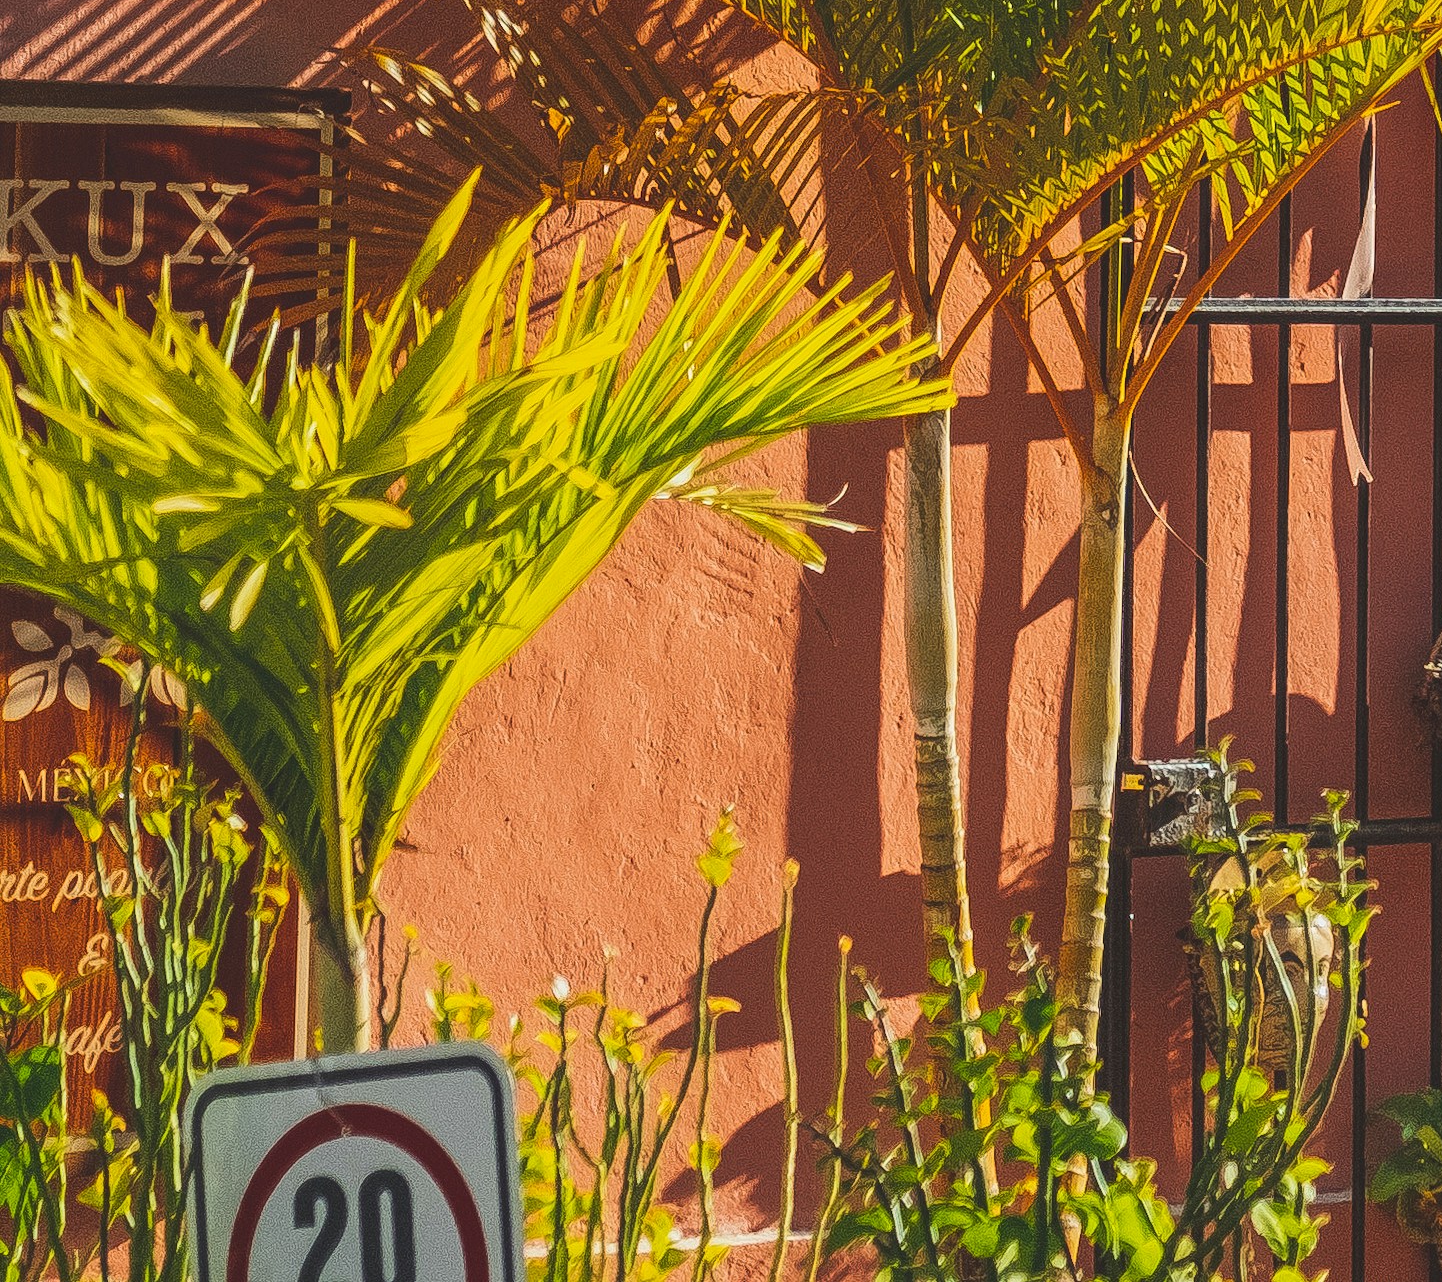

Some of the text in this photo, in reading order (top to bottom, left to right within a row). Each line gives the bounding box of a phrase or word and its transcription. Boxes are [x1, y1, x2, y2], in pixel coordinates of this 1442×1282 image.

[0, 179, 249, 266] KUX
[77, 933, 109, 977] &
[294, 1169, 416, 1282] 20
